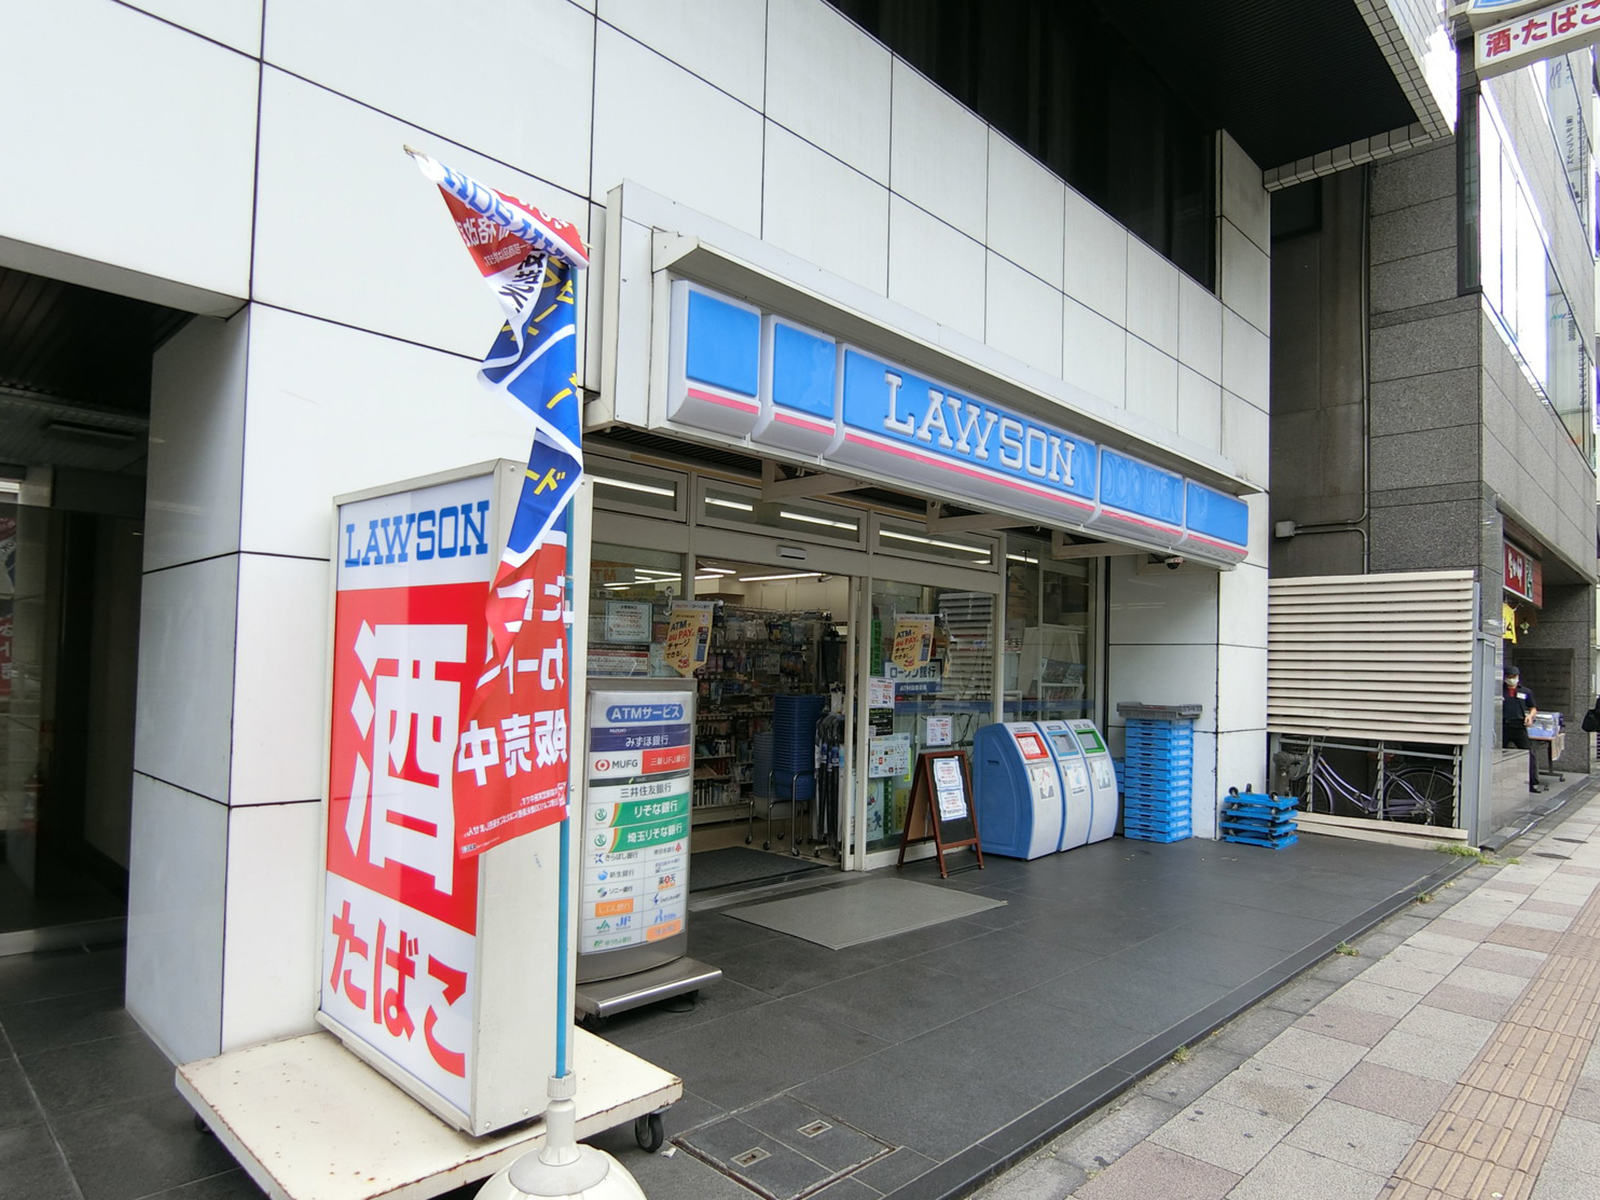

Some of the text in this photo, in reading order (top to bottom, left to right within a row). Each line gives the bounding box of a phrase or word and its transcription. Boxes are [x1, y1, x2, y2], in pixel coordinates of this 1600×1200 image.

[884, 371, 1075, 487] LAWSON
[345, 500, 490, 568] LAWSON
[667, 639, 690, 651] チャージ
[895, 644, 915, 654] チャージ
[611, 705, 680, 720] ATMサービス
[625, 735, 669, 748] みずほ銀行
[345, 619, 468, 896] 酒
[611, 759, 638, 769] MUFG
[620, 783, 672, 798] 三井住友銀行
[634, 800, 678, 817] りそな銀行
[627, 823, 683, 843] 埼玉りそな銀行
[609, 886, 633, 895] ソニー銀行
[330, 900, 468, 1079] たばこ
